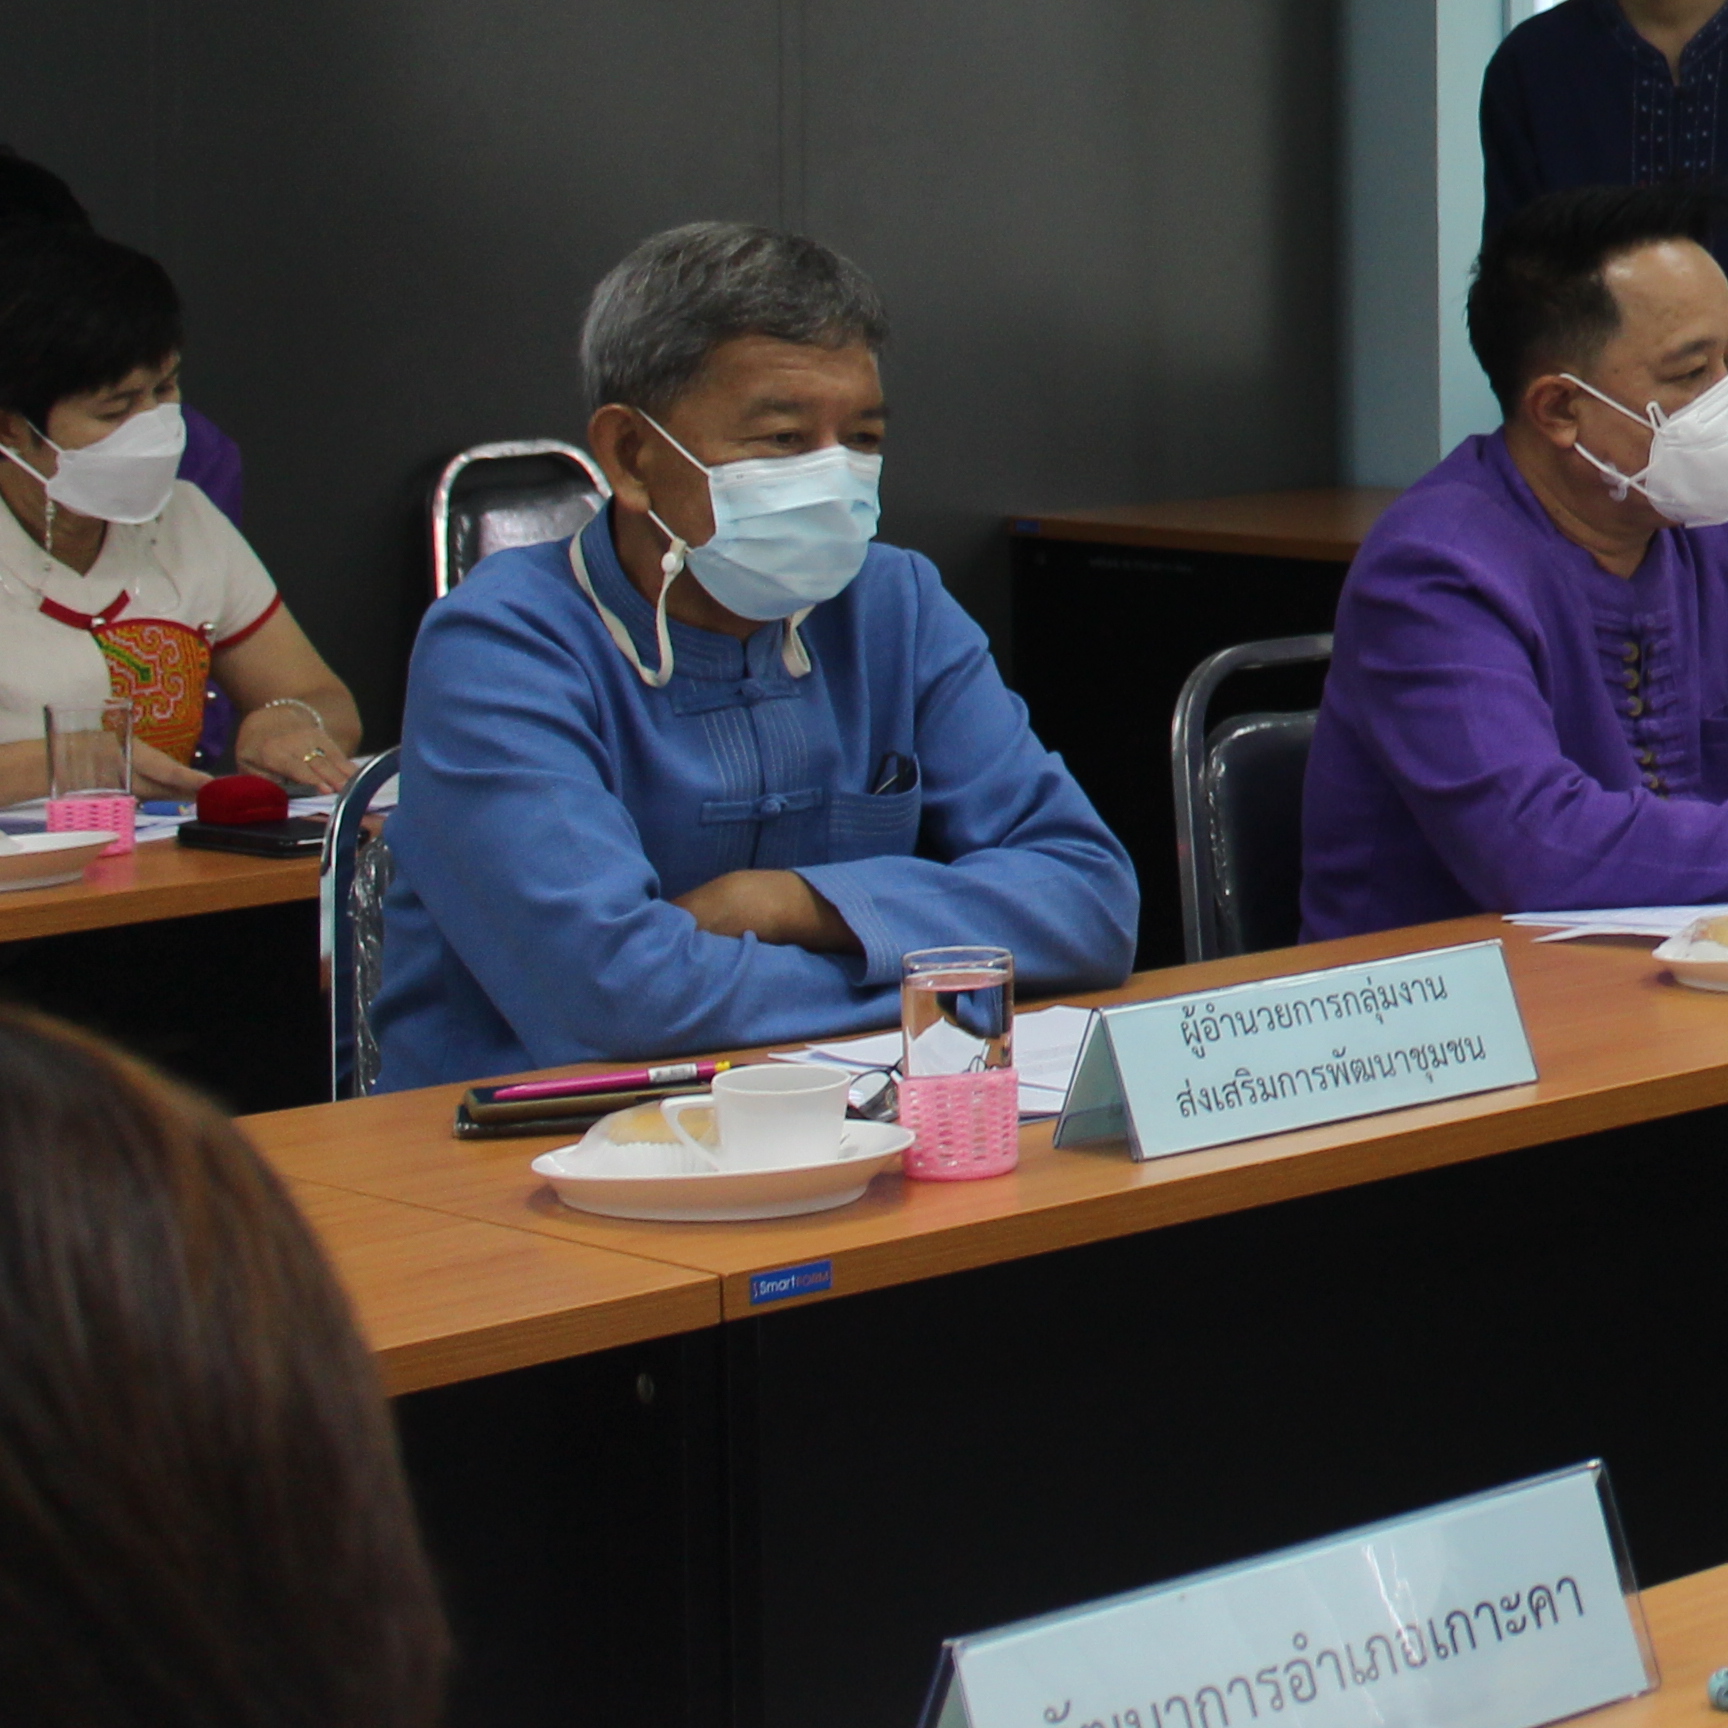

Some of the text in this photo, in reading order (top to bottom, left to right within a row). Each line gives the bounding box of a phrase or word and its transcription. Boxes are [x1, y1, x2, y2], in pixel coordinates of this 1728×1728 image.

[1180, 973, 1448, 1058] ผู้อำนวยการกลุ่มงาน
[1176, 1034, 1487, 1118] ส่งเสริมการพัฒนาชุมชน
